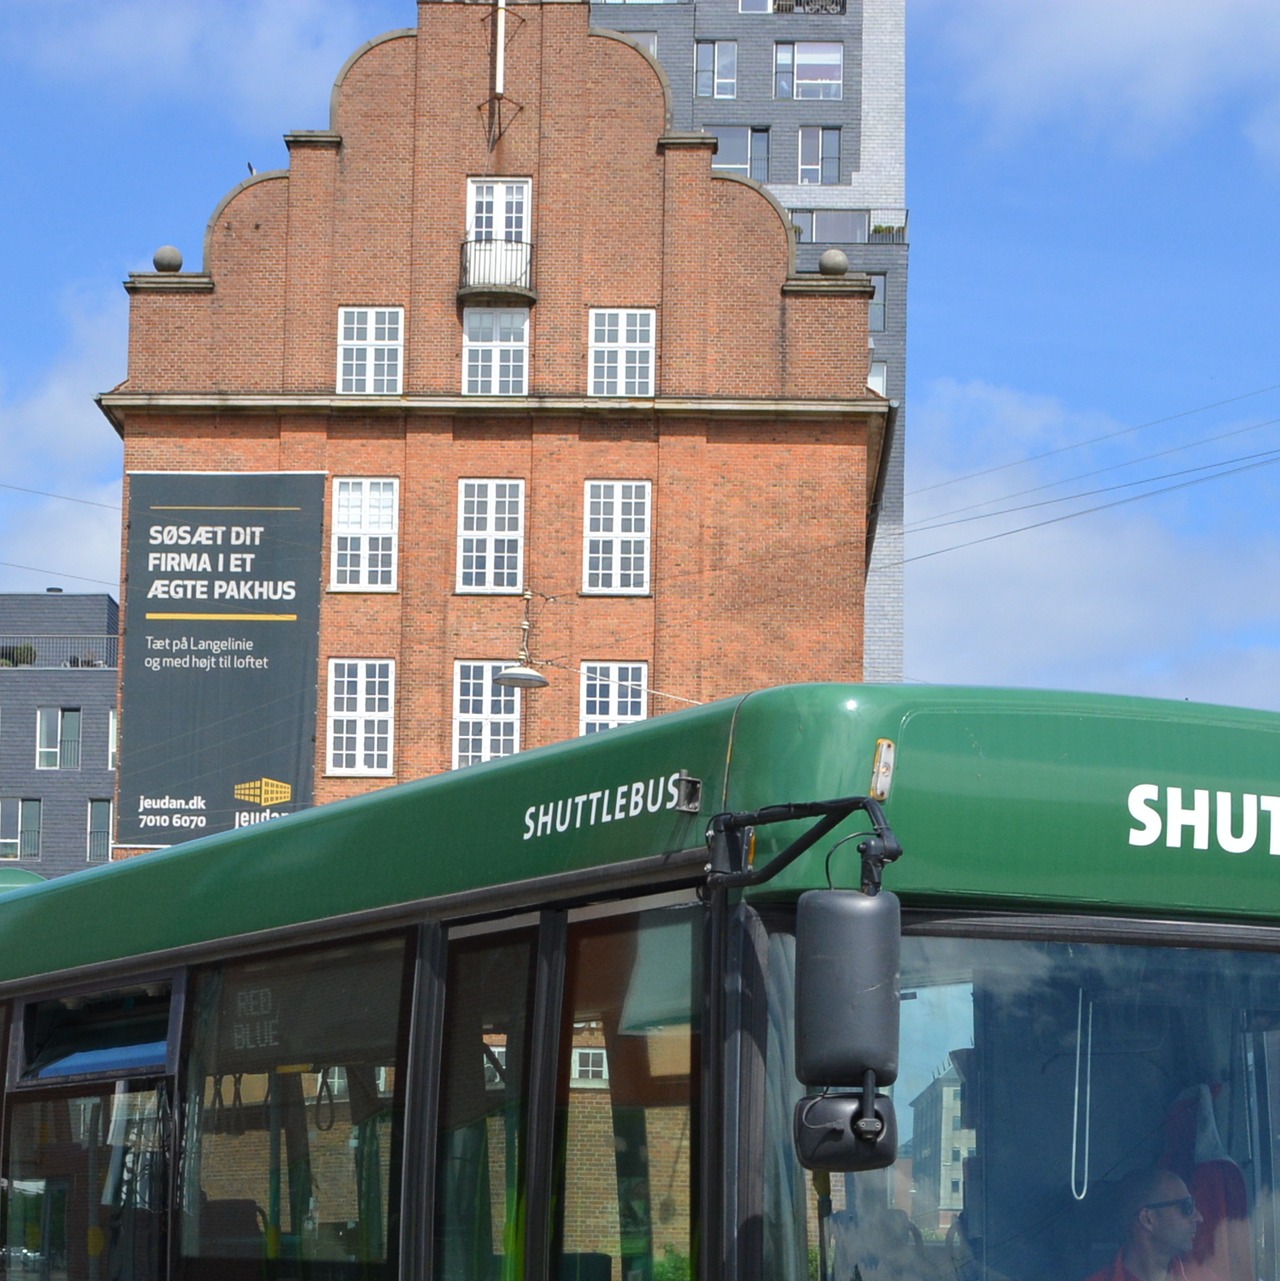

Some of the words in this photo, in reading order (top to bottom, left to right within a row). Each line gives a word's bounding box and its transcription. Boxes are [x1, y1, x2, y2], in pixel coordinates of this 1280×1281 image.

[149, 525, 226, 545] SØSÆT
[230, 526, 264, 545] DIT
[148, 553, 212, 572] FIRMA
[218, 553, 224, 572] I
[229, 553, 255, 572] ET
[147, 579, 208, 599] ÆGTE
[214, 580, 296, 600] PAKHUS
[145, 636, 170, 650] Tæt
[172, 636, 188, 652] på
[190, 636, 254, 653] Langelinie
[144, 656, 160, 671] og
[162, 655, 189, 667] med
[192, 655, 216, 671] højt
[218, 655, 231, 668] til
[233, 655, 269, 669] loftet
[138, 795, 207, 812] jeudan.dk
[522, 772, 680, 841] SHUTTLEBUS
[138, 815, 169, 828] 7010
[172, 814, 207, 829] 6070
